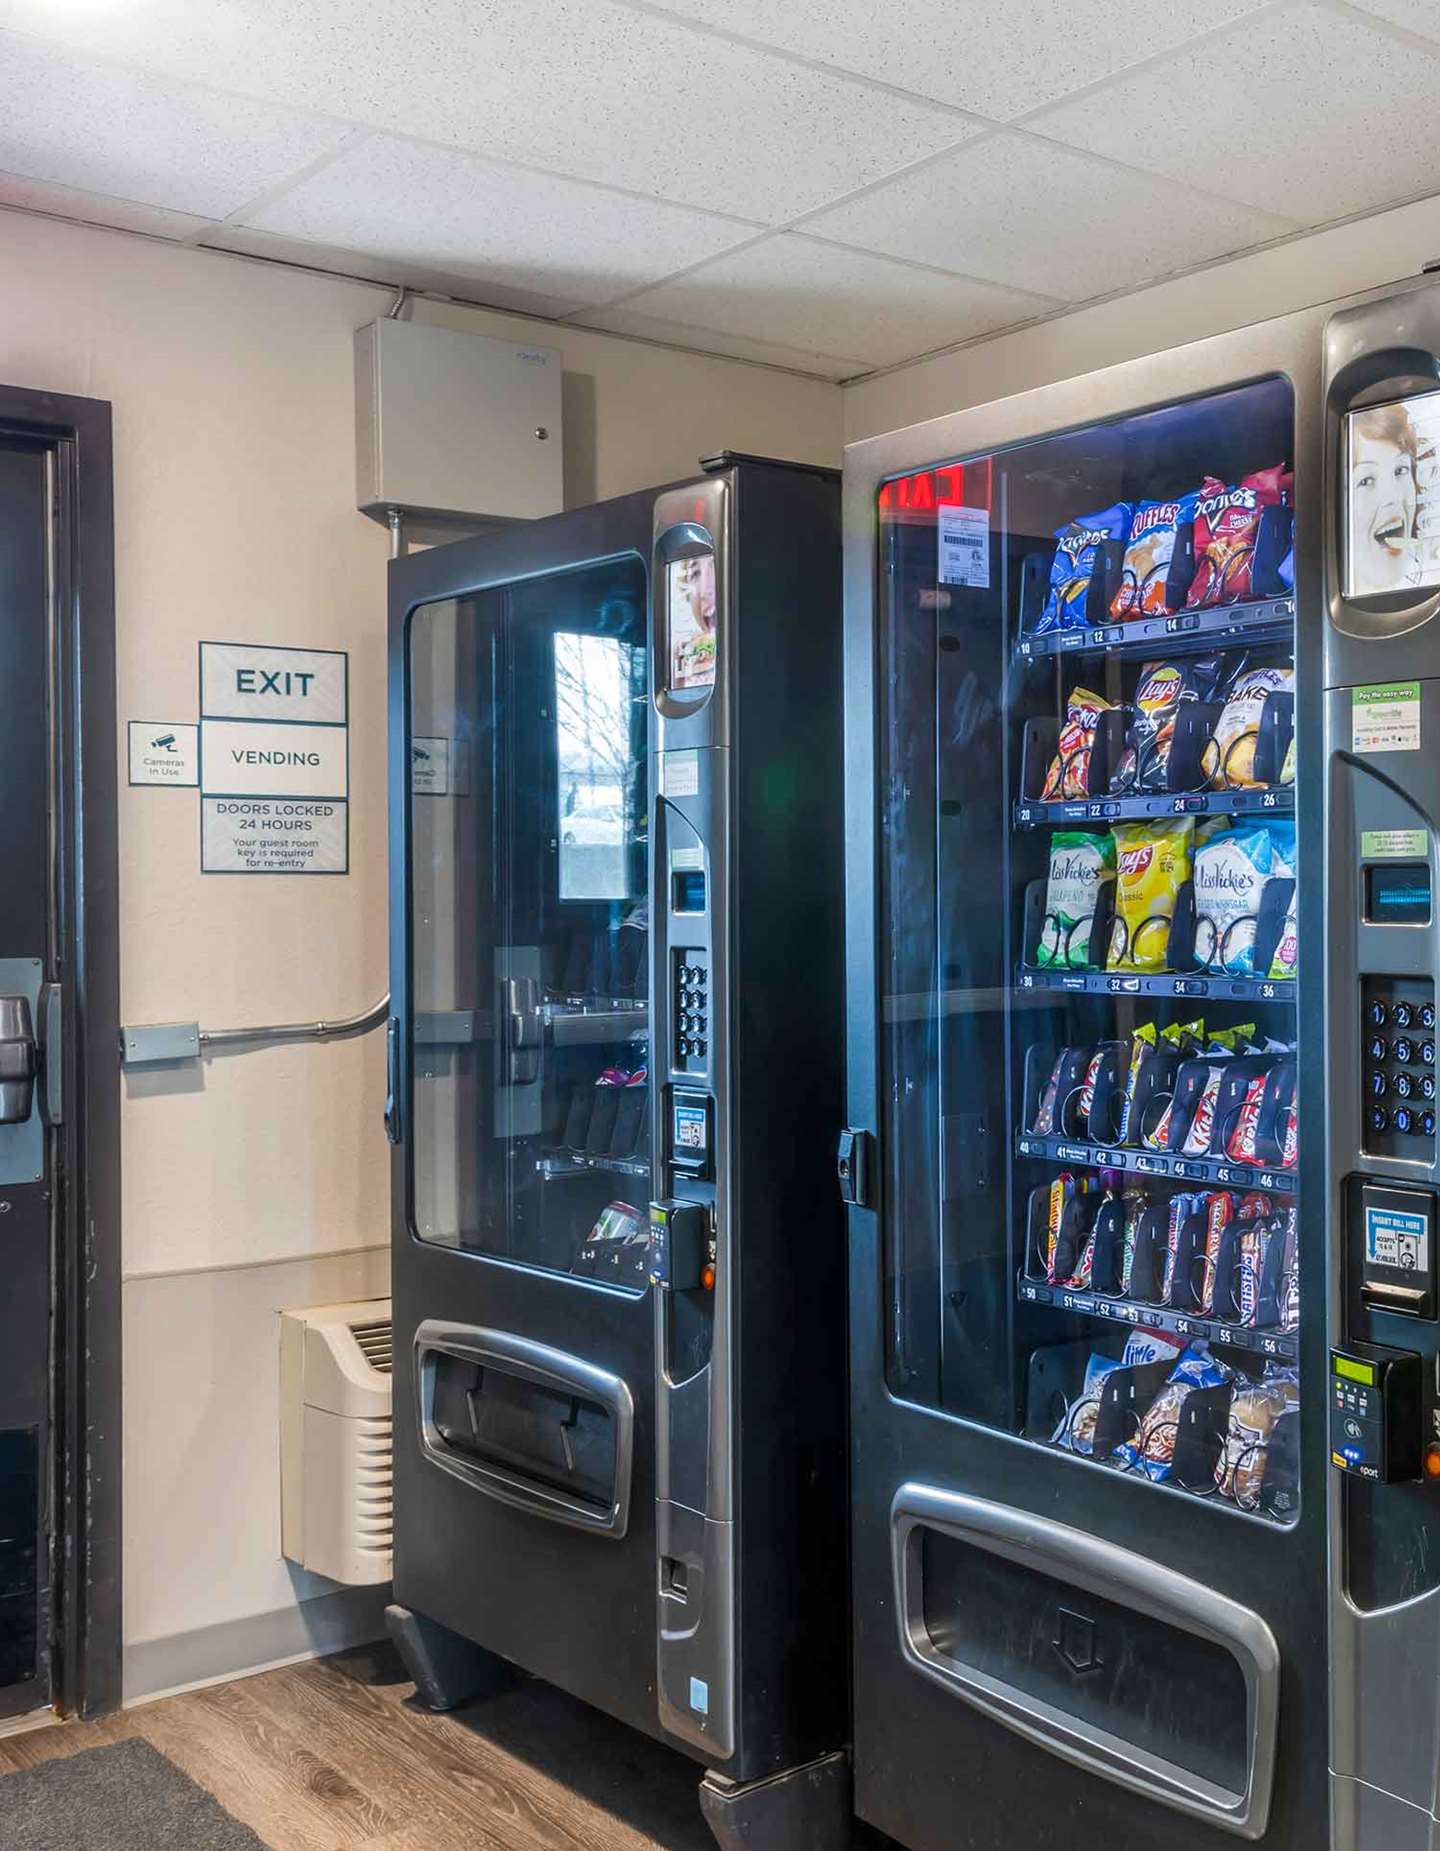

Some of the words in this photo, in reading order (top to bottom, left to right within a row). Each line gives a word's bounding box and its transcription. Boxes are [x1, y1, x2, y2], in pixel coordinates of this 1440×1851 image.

[1167, 618, 1177, 631] 14
[1093, 631, 1103, 642] 12
[1020, 643, 1030, 654] 10
[236, 669, 315, 696] EXIT
[143, 757, 184, 767] Cameras
[231, 750, 320, 766] VENDING
[149, 767, 158, 775] In
[161, 768, 179, 776] Use
[1174, 800, 1185, 811] 24
[1264, 794, 1275, 806] 26
[216, 803, 270, 815] DOORS
[275, 804, 333, 817] LOCKED
[1021, 810, 1030, 820] 20
[1090, 805, 1101, 817] 22
[239, 819, 256, 830] 24
[262, 820, 312, 831] HOURS
[232, 838, 256, 847] Your
[259, 839, 288, 849] guest
[237, 848, 255, 858] key
[259, 849, 267, 857] is
[270, 848, 314, 859] required
[245, 858, 261, 866] for
[264, 859, 306, 869] re-entry
[1023, 976, 1033, 987] 30
[1110, 979, 1120, 991] 32
[1175, 979, 1185, 992] 34
[1263, 984, 1274, 998] 36
[1373, 1005, 1380, 1022] 1
[1398, 1012, 1406, 1024] 2
[1423, 1012, 1432, 1026] 3
[1372, 1043, 1381, 1058] 4
[1398, 1044, 1406, 1059] 5
[1423, 1046, 1432, 1062] 6
[1373, 1076, 1381, 1093] 7
[1398, 1077, 1406, 1094] 8
[1423, 1080, 1432, 1096] 9
[1398, 1115, 1406, 1129] 0
[1020, 1142, 1029, 1154] 40
[1057, 1147, 1067, 1158] 41
[1096, 1153, 1106, 1165] 42
[1136, 1157, 1147, 1169] 43
[1175, 1162, 1185, 1175] 44
[1217, 1168, 1229, 1181] 45
[1261, 1175, 1272, 1188] 46
[1026, 1288, 1036, 1300] 50
[1064, 1296, 1073, 1307] 51
[1100, 1304, 1110, 1316] 52
[1128, 1308, 1139, 1321] 53
[1177, 1320, 1188, 1333] 54
[1220, 1330, 1231, 1343] 55
[1264, 1339, 1276, 1353] 56
[1359, 1466, 1379, 1478] eport
